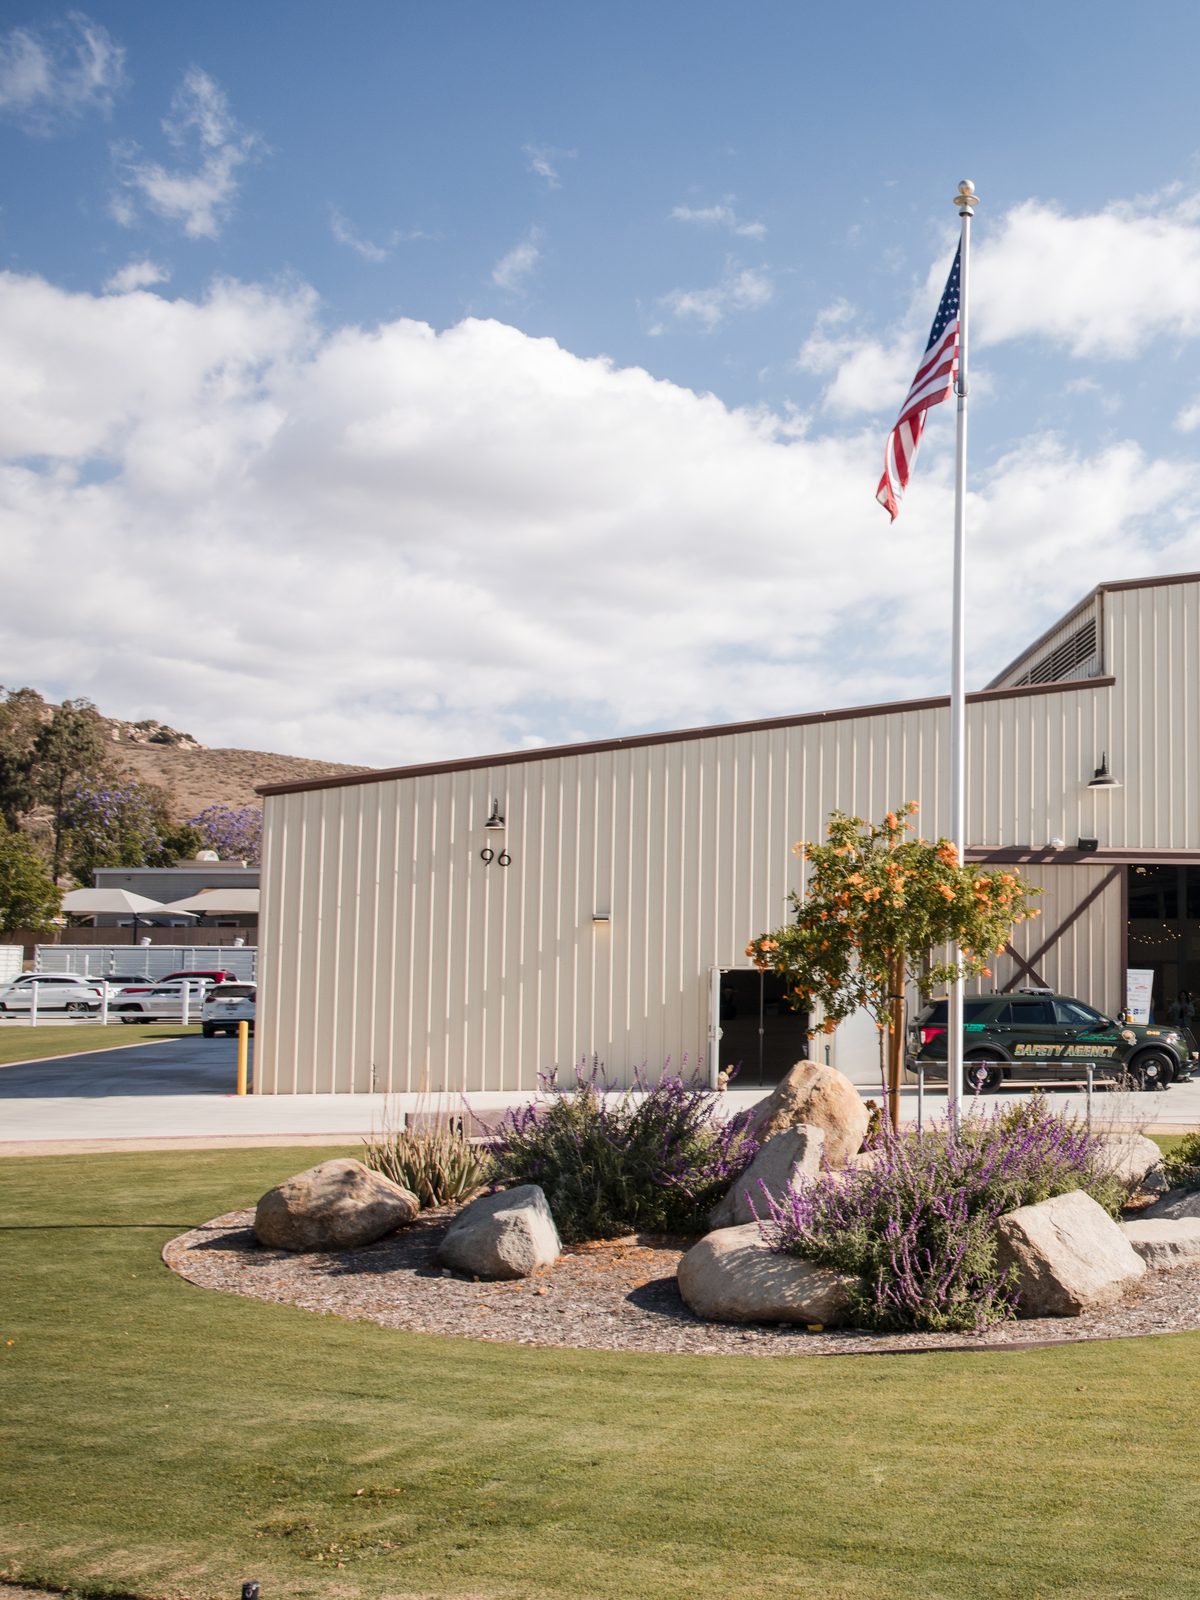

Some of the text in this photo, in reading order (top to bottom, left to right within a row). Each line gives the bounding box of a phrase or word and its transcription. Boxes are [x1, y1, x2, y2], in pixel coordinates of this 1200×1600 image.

[480, 848, 512, 867] 96
[1014, 1044, 1117, 1058] SAFETY AGENCY
